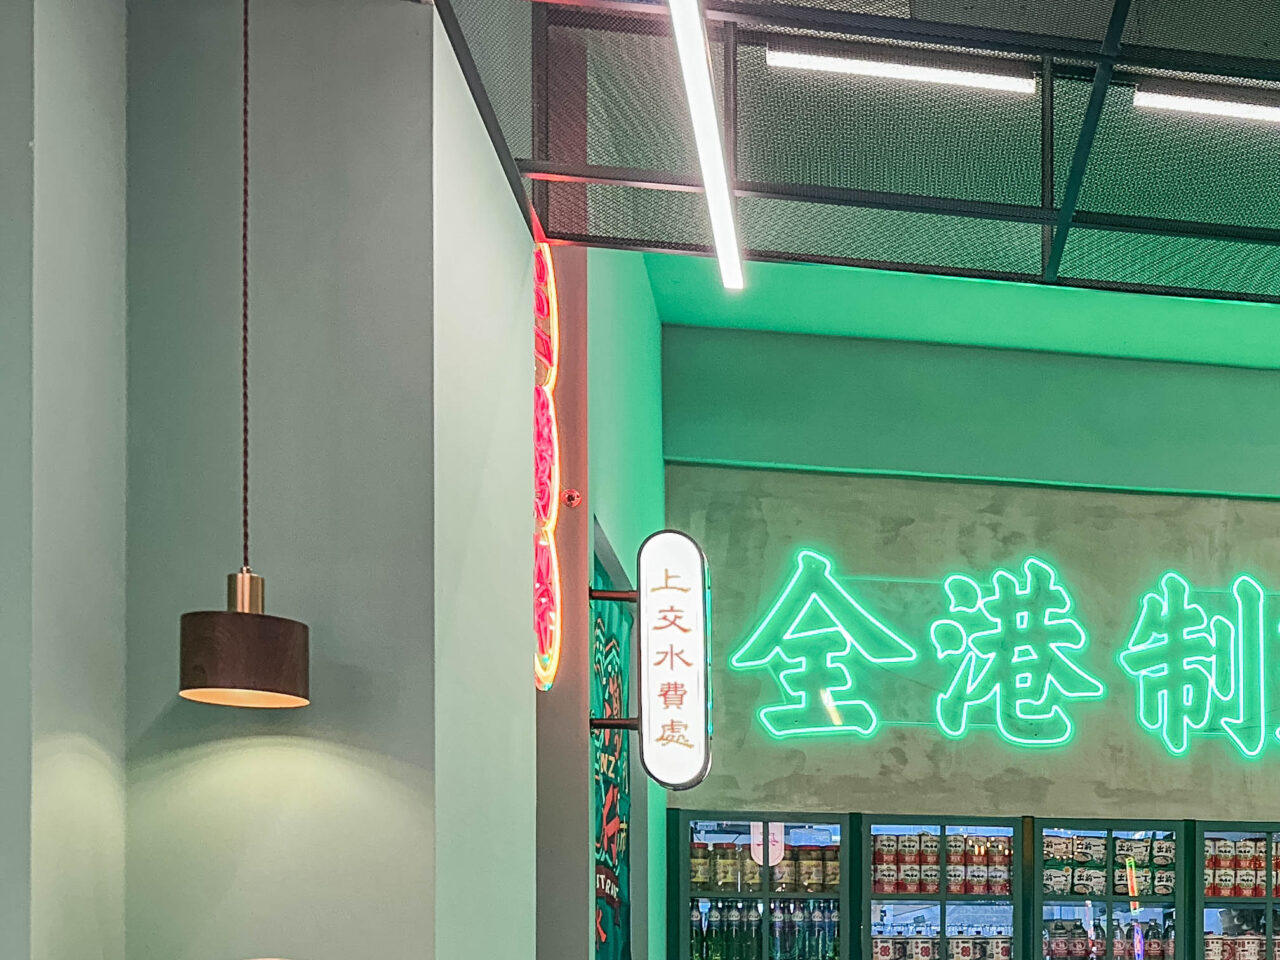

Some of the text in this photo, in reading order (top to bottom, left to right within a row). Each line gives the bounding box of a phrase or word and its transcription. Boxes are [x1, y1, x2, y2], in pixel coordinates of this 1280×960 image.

[650, 567, 695, 749] 上交水費處
